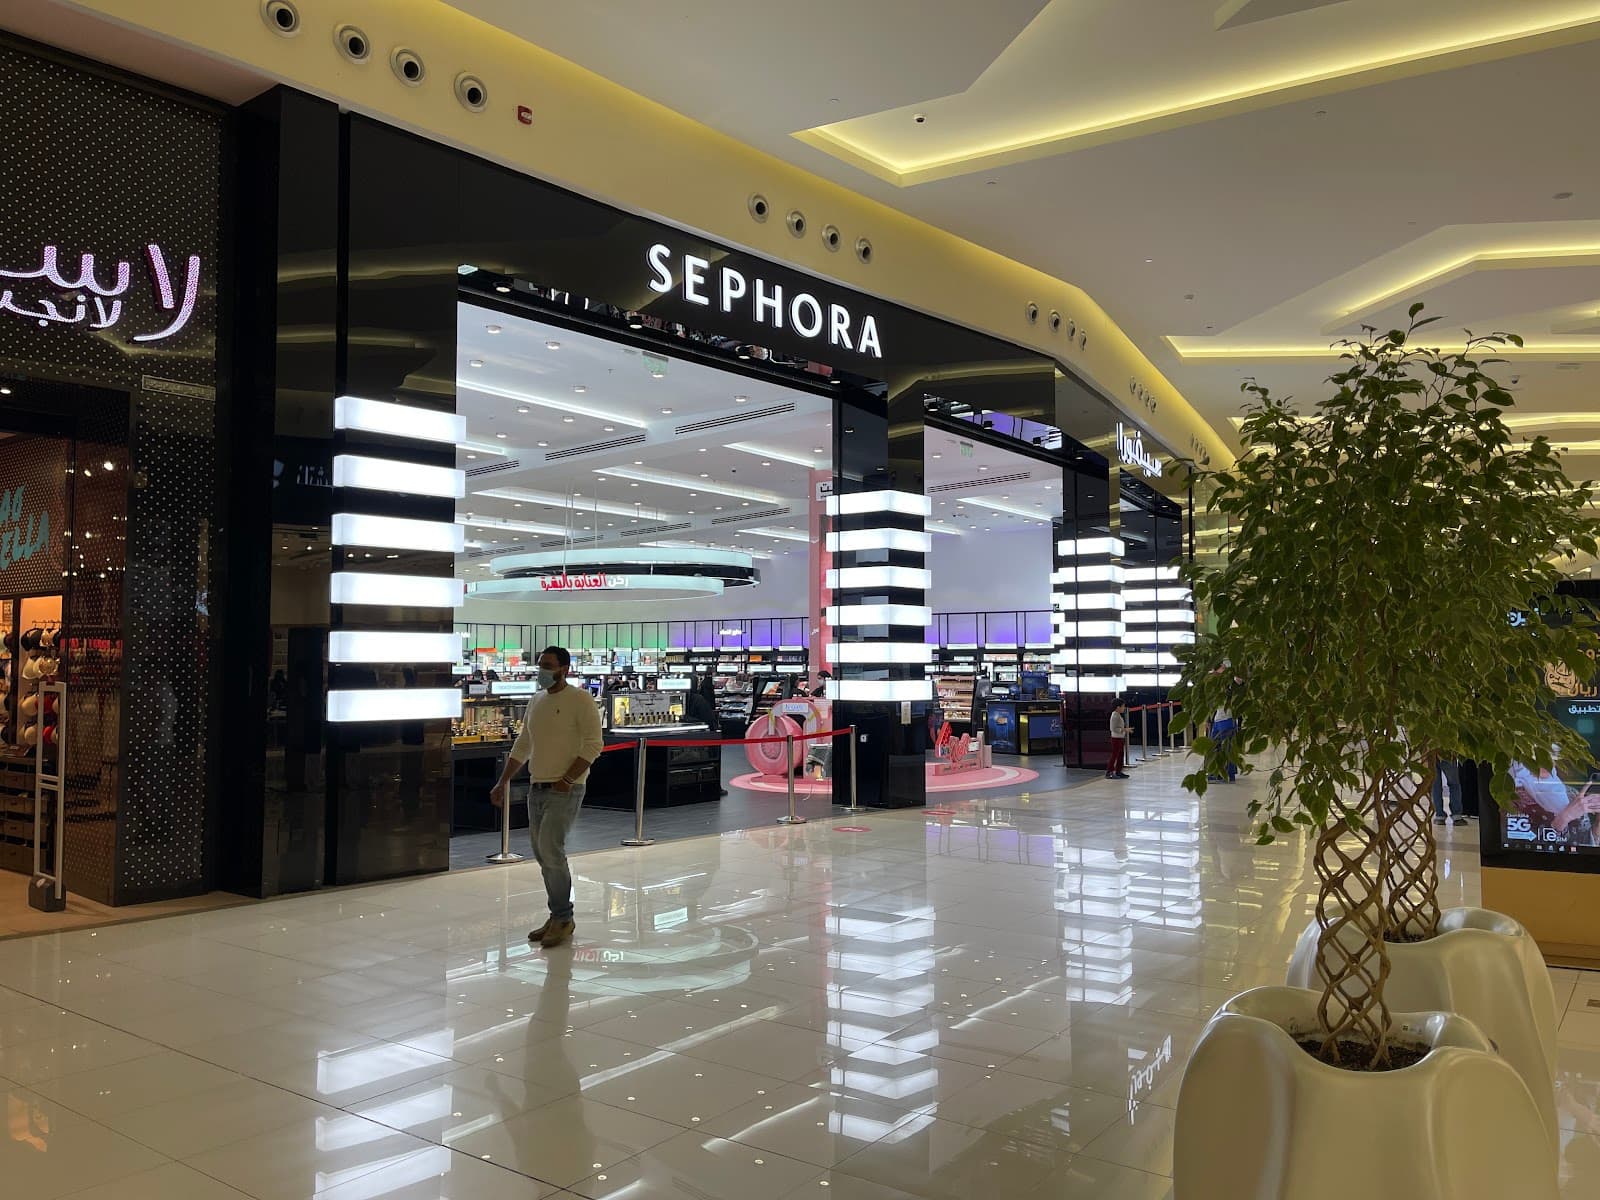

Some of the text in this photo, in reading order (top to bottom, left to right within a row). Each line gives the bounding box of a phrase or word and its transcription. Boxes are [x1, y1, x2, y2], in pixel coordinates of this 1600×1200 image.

[647, 243, 882, 358] SEPHORA
[1116, 422, 1162, 478] سيفورا
[574, 572, 608, 590] العناية
[608, 574, 629, 587] ركن
[1507, 817, 1531, 832] 5G
